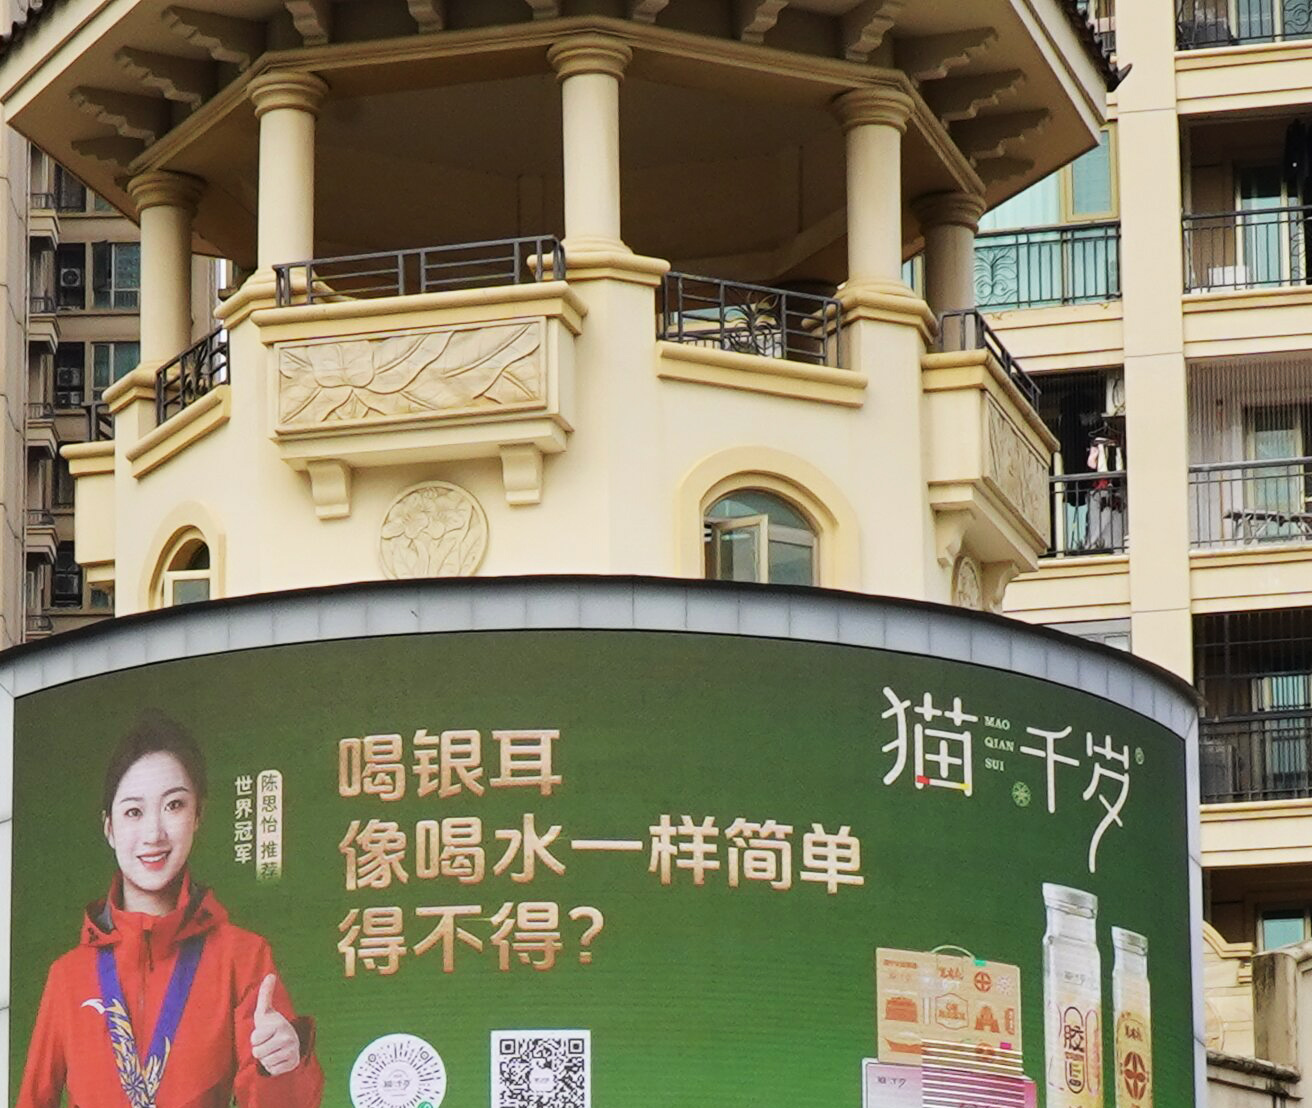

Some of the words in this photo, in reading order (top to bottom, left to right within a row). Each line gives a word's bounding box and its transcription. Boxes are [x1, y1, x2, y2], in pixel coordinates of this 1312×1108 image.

[985, 716, 1010, 730] MAO
[985, 737, 1015, 752] QIAN
[338, 728, 562, 802] 喝银耳
[985, 758, 1005, 772] SUI
[234, 775, 253, 865] 世界冠军
[338, 812, 866, 895] 像喝水一样简单
[337, 901, 605, 979] 得不得?
